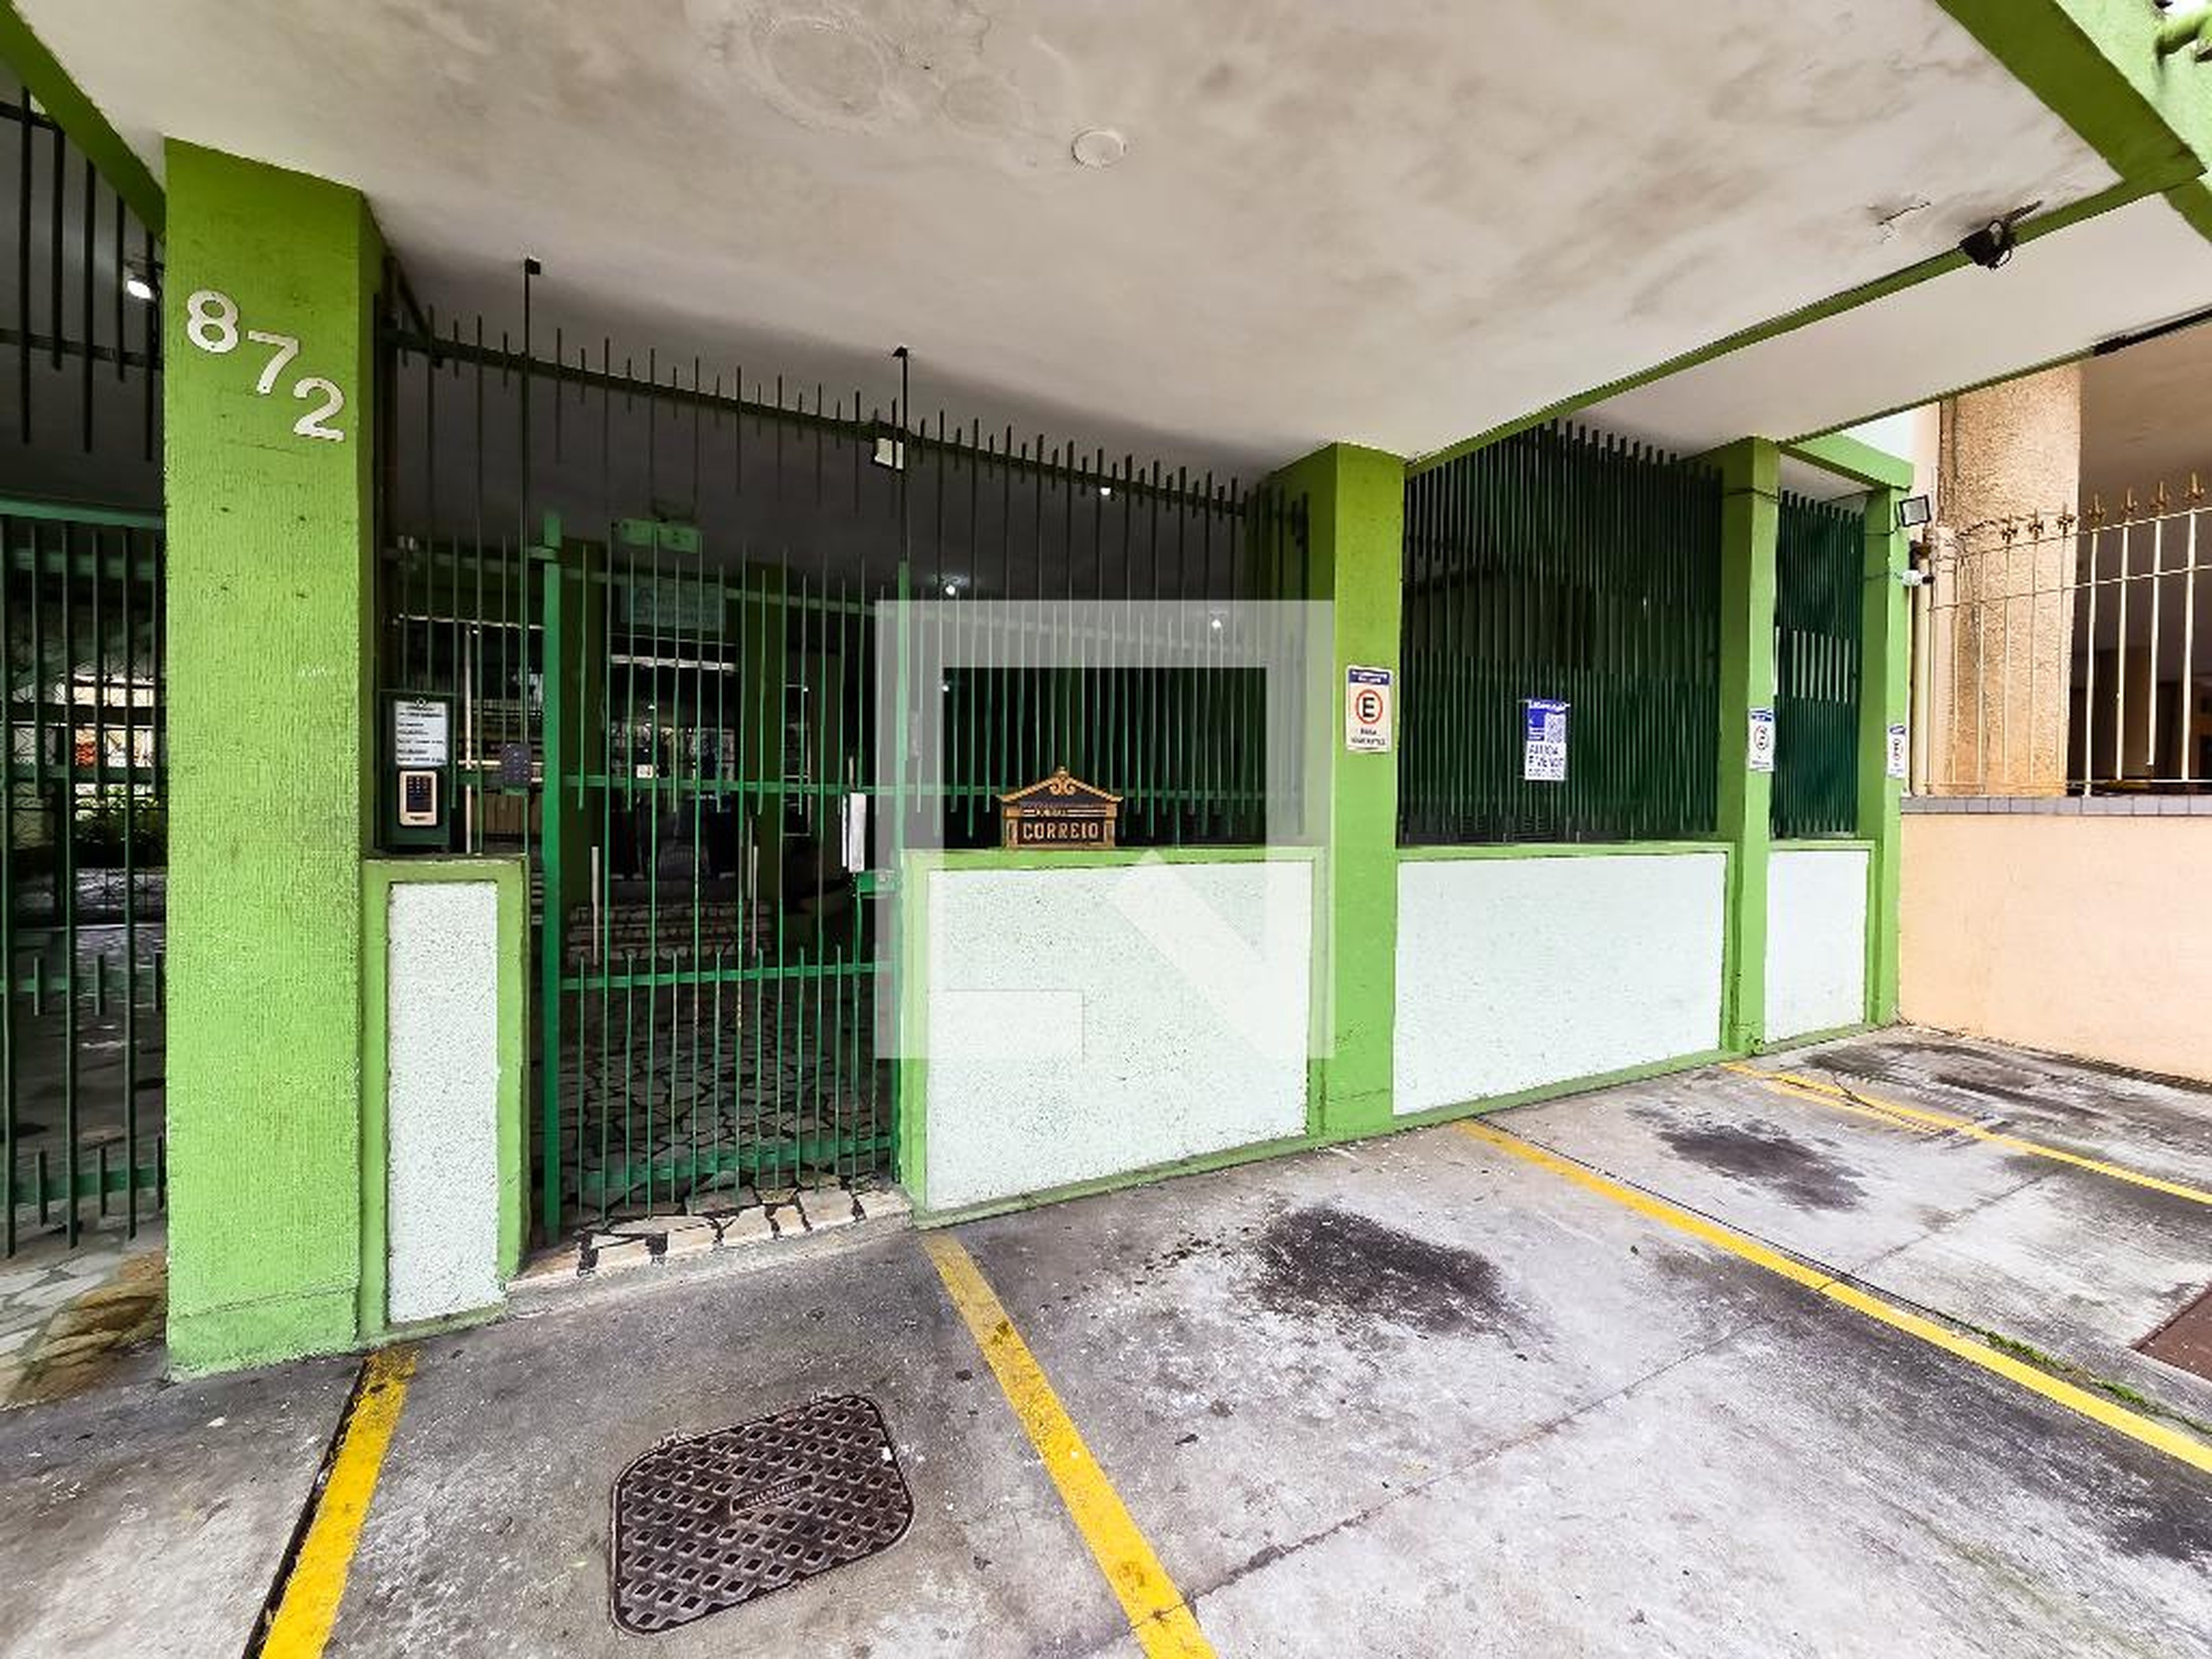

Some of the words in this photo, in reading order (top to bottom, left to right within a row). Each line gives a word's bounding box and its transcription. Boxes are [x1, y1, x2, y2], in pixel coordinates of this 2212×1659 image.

[187, 290, 344, 441] 872
[1362, 697, 1375, 718] E
[1022, 822, 1099, 839] CORREIO
